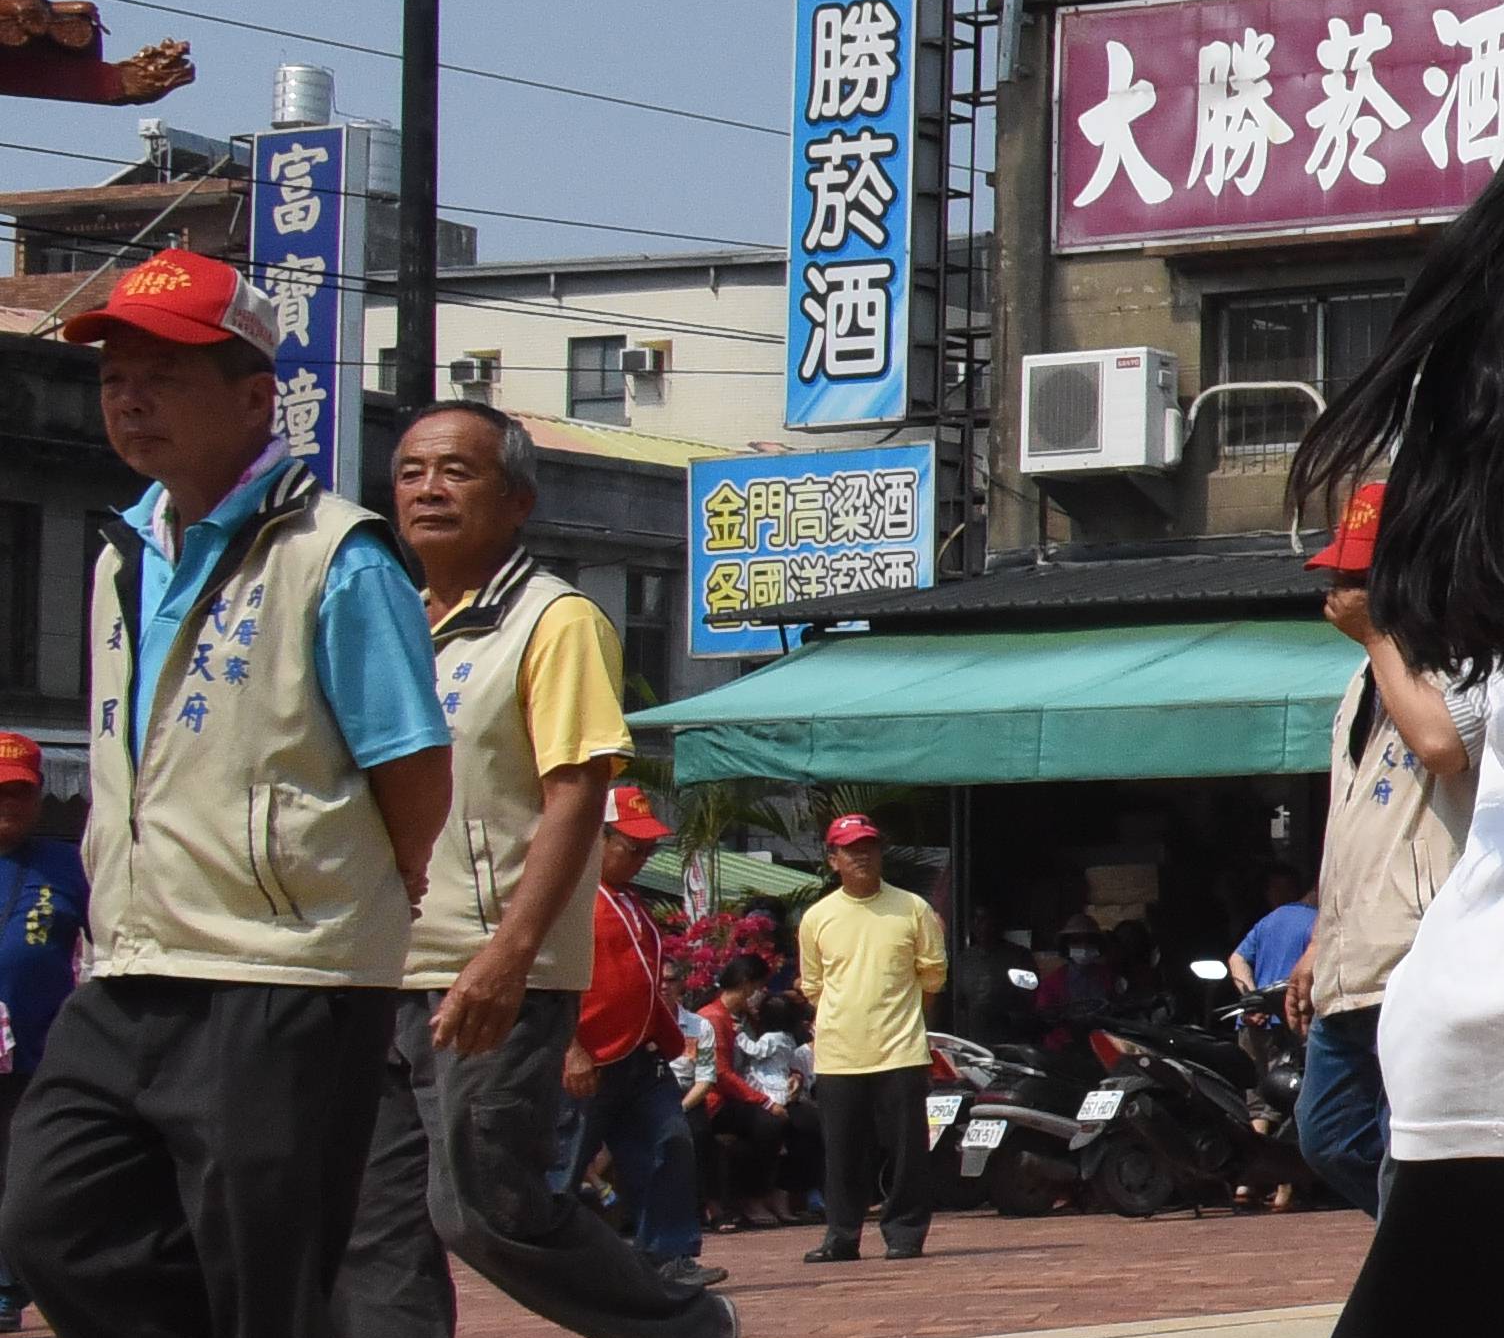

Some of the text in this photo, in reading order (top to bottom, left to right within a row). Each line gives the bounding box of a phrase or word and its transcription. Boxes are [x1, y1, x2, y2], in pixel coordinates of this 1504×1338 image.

[704, 470, 917, 553] 金門高粱酒
